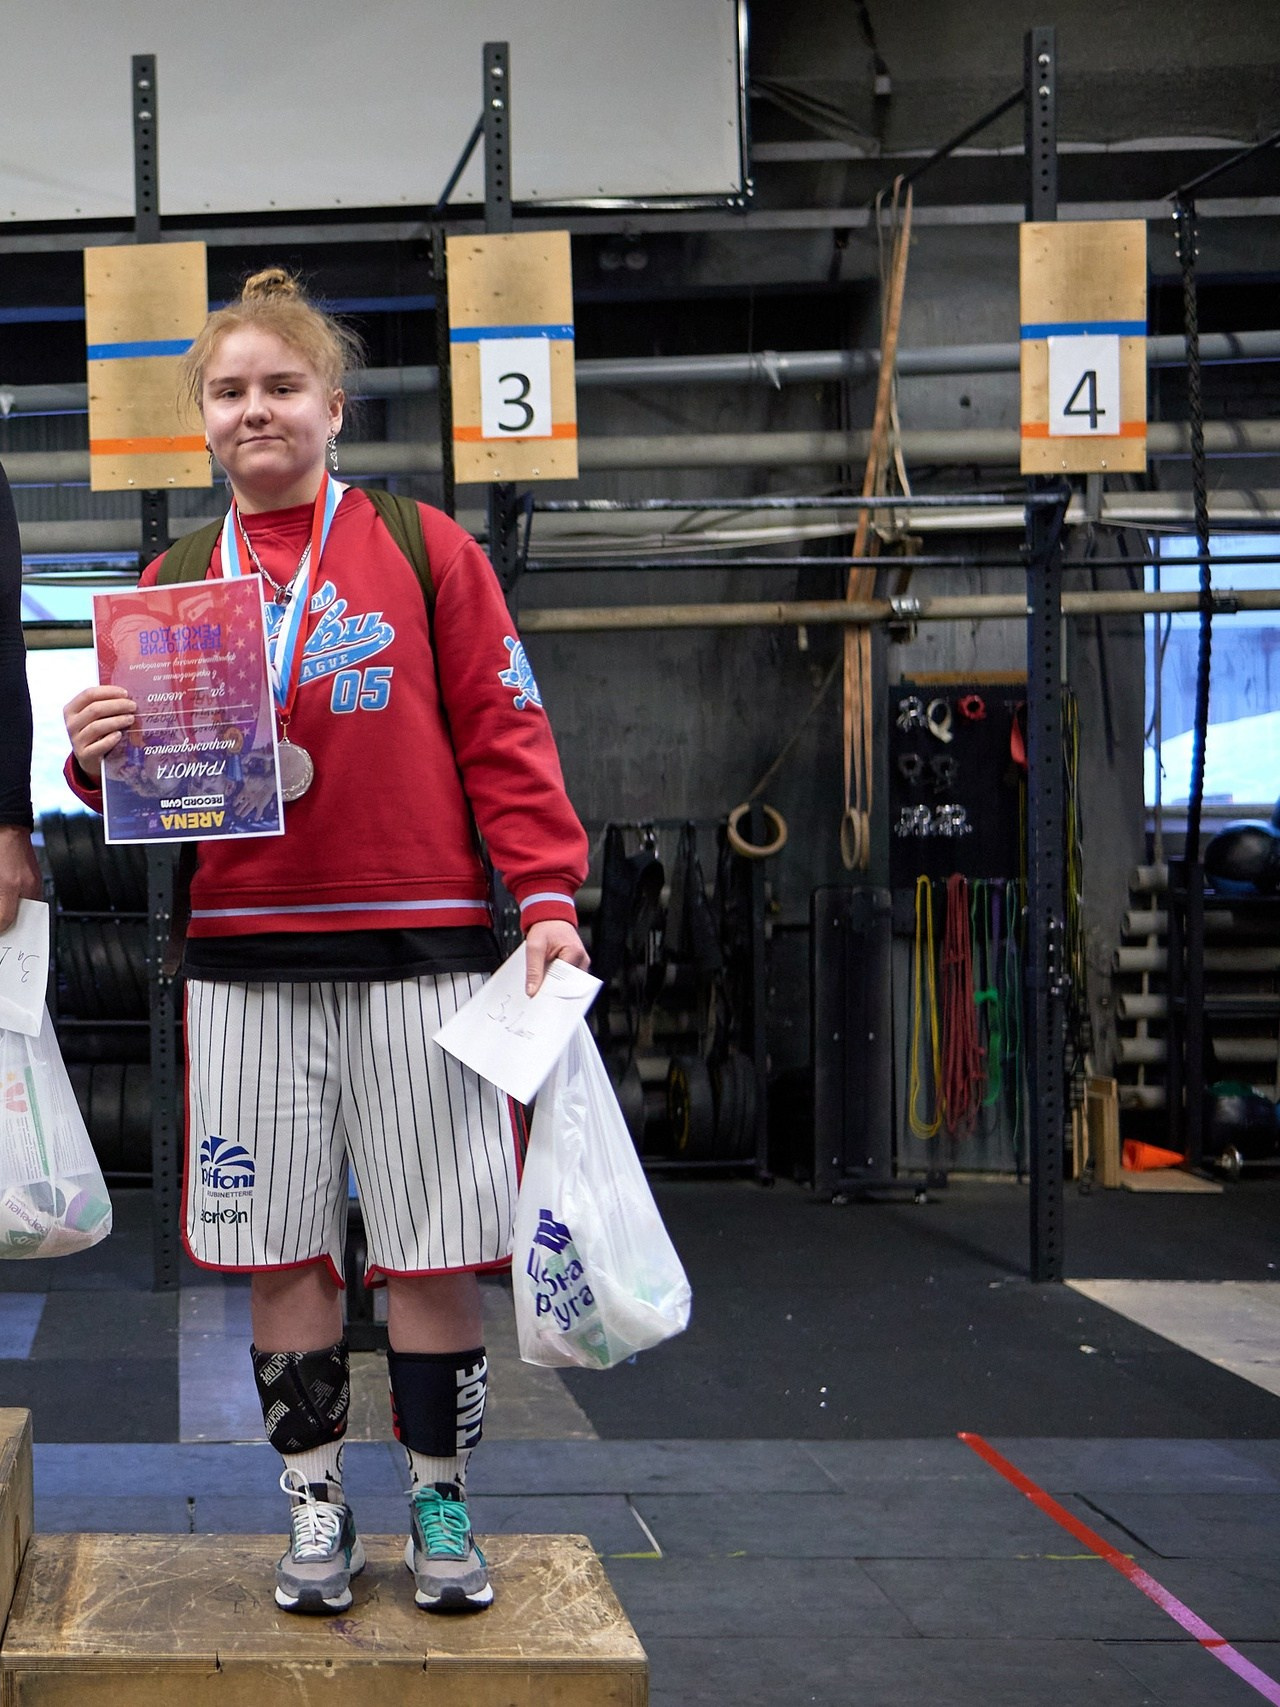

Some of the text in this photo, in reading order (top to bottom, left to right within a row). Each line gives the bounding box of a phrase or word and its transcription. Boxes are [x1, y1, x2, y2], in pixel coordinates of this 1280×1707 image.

[498, 372, 534, 432] 3
[1063, 370, 1106, 429] 4
[139, 624, 222, 645] РЕКОРДОВ
[140, 638, 223, 656] ТЕРРИТОРИЯ
[303, 654, 349, 678] AGUE
[147, 682, 226, 703] за место
[330, 667, 394, 714] 05
[144, 737, 236, 756] награждается
[157, 760, 227, 780] ГРАМОТА
[160, 795, 224, 809] RECORD GYM
[160, 810, 225, 830] ARENA
[260, 1352, 308, 1386] OCKTAPE
[328, 1385, 349, 1421] CKTAPE
[265, 1401, 290, 1436] ROCKTA
